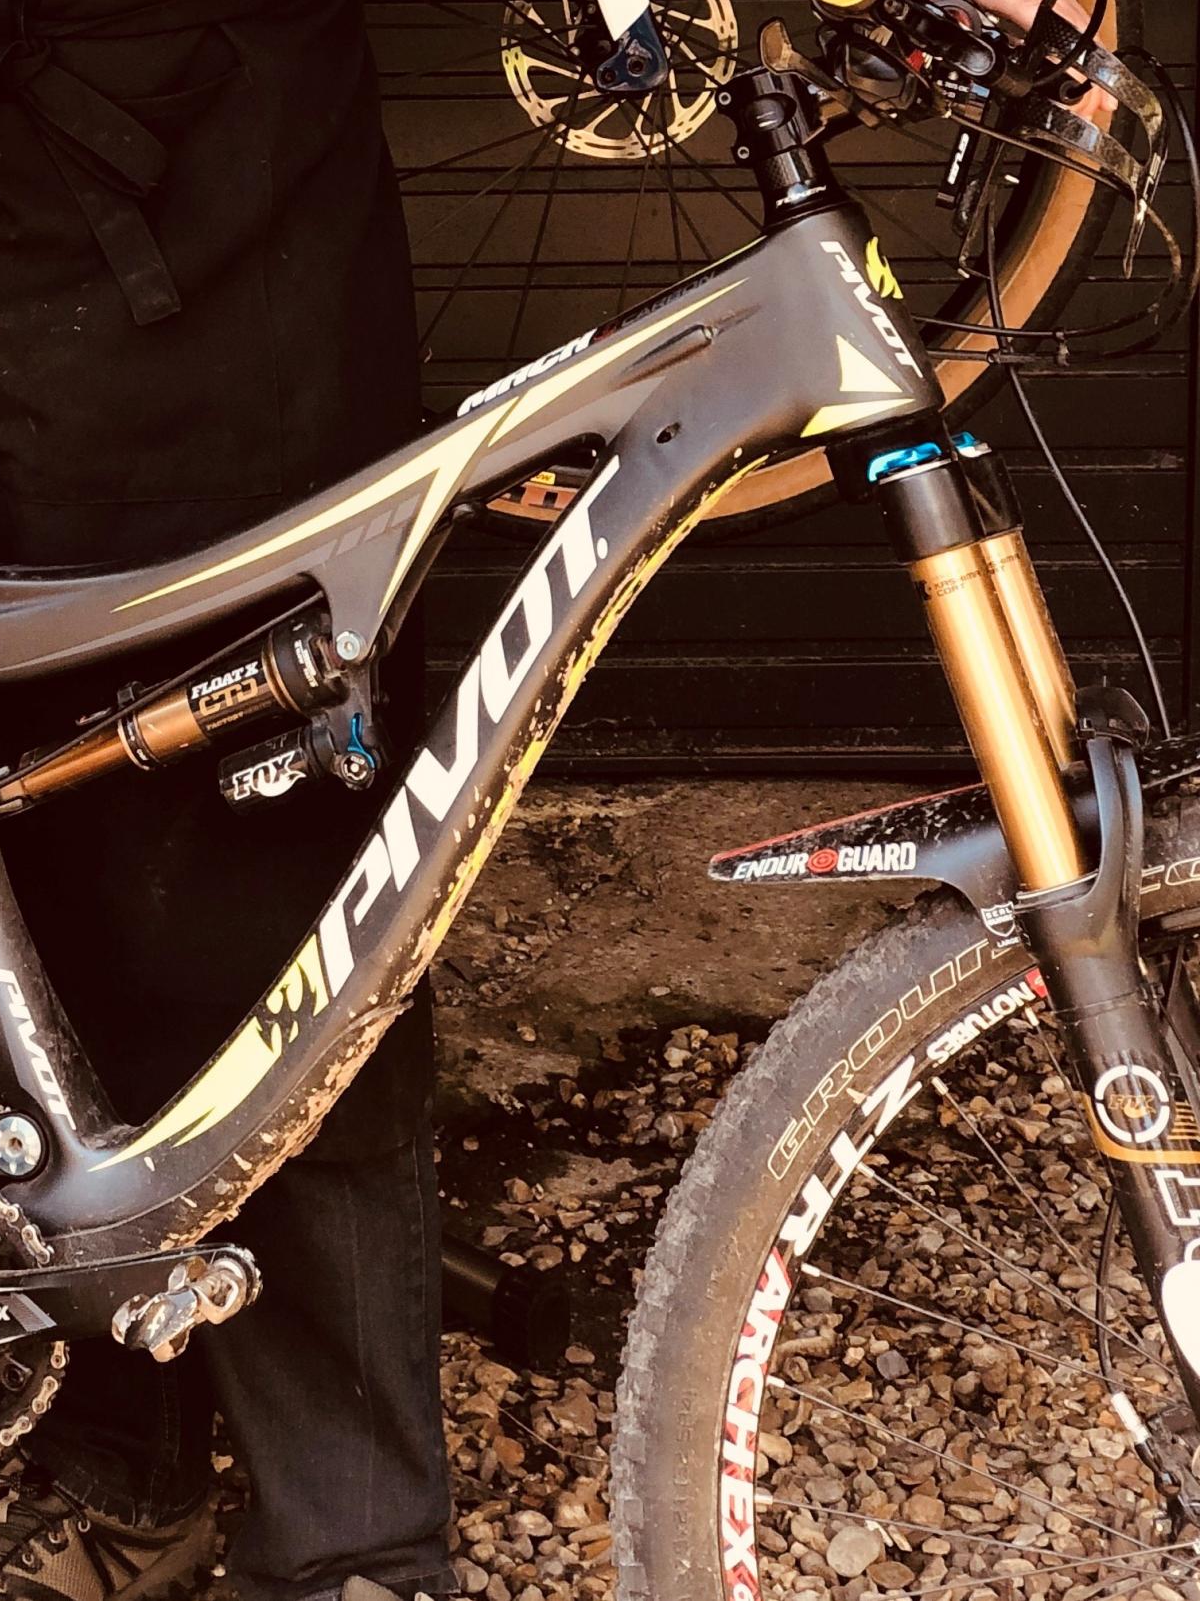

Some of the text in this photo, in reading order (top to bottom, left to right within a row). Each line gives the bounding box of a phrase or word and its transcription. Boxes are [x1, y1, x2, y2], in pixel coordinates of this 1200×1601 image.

[820, 241, 923, 378] PIVOT
[456, 327, 597, 418] MACH
[191, 666, 243, 700] FLOAT
[198, 677, 259, 717] CTD
[232, 750, 307, 801] FOX
[927, 981, 1037, 1069] NOTUBES
[780, 1054, 923, 1257] ZTR
[721, 1247, 792, 1463] ARCH
[720, 1482, 759, 1575] EX
